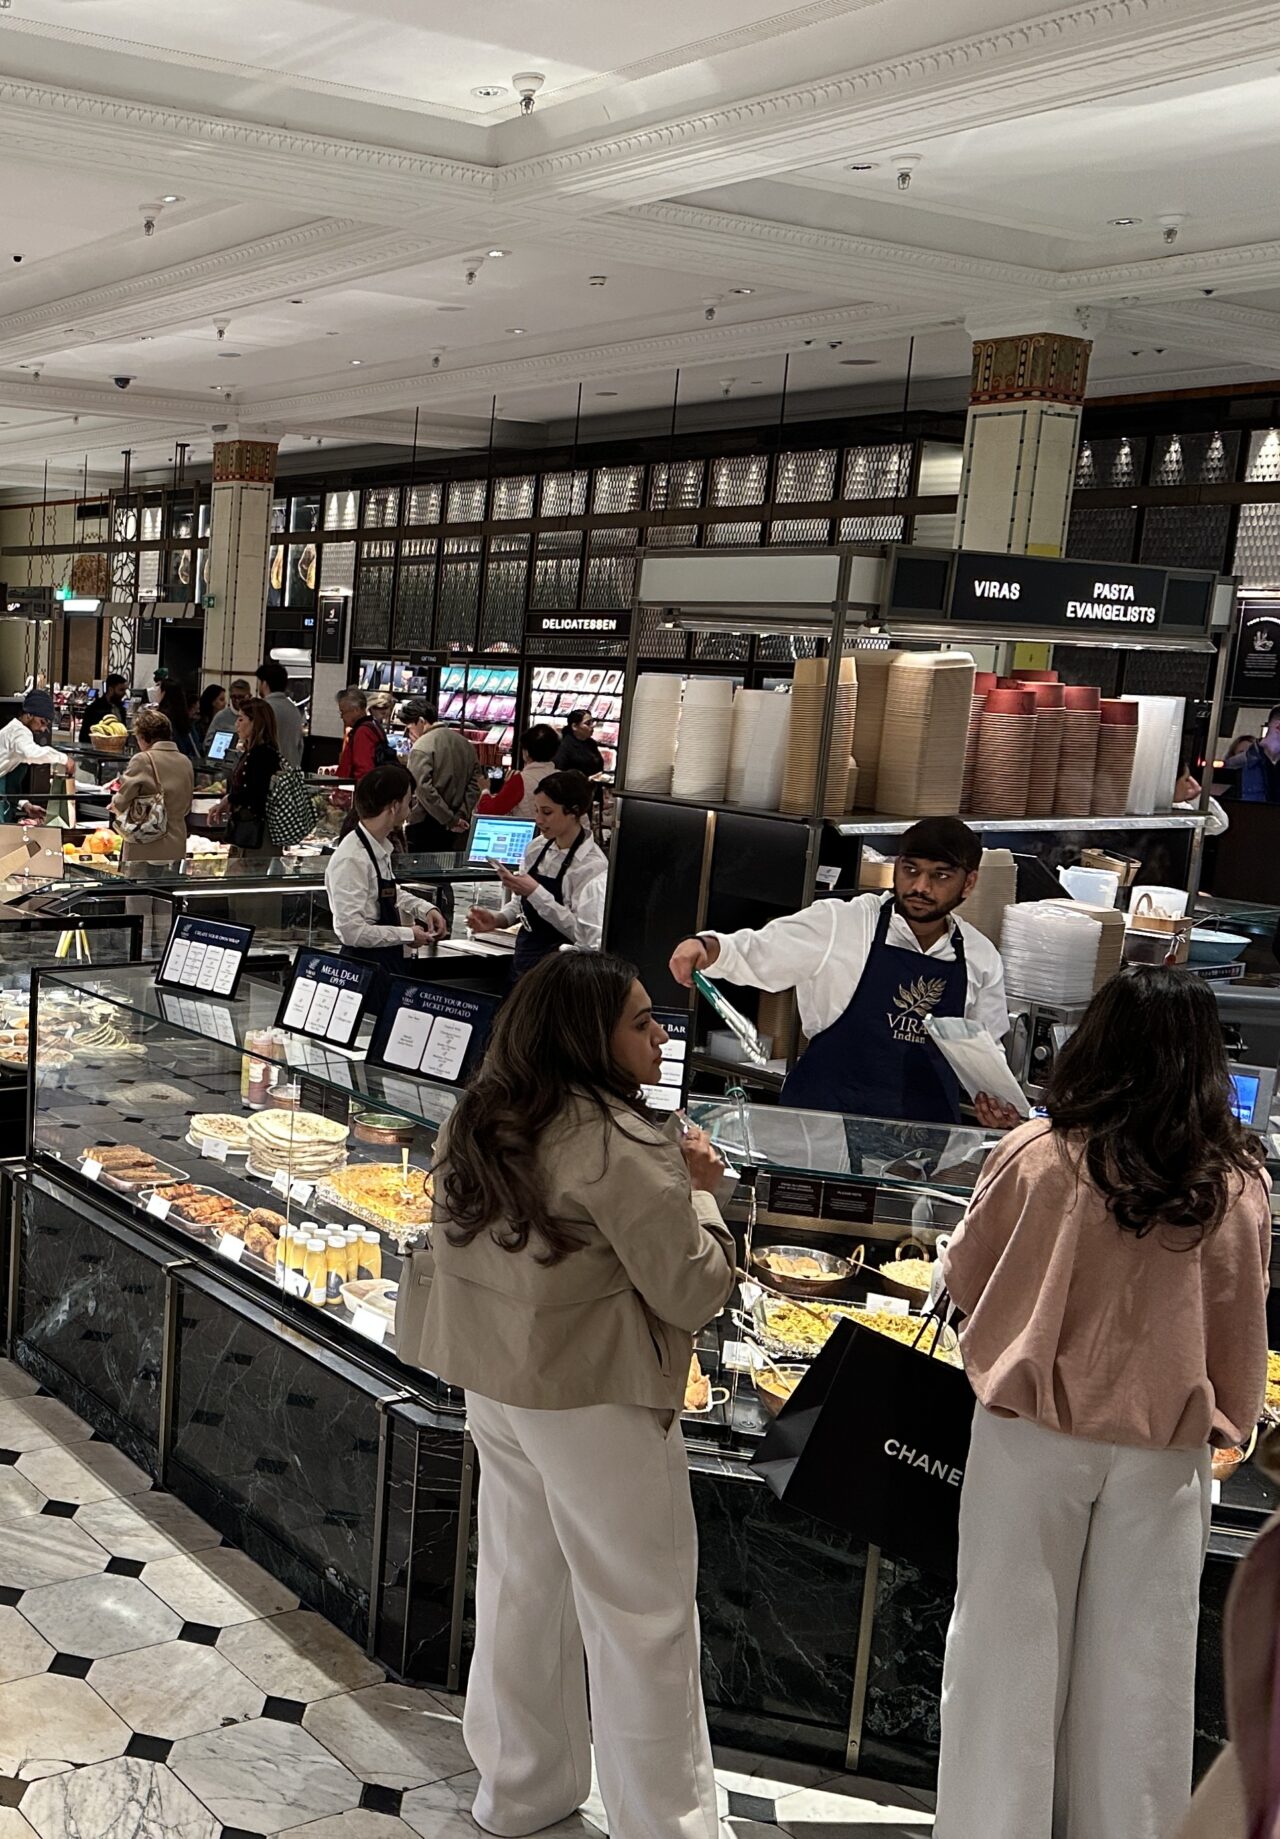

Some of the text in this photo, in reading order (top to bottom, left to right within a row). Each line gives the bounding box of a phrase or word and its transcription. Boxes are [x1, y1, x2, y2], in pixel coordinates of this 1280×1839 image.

[974, 580, 1020, 600] VIRAS
[1093, 583, 1134, 601] PASTA
[1066, 601, 1156, 623] EVANGELISTS
[541, 618, 617, 631] DELICATESSEN
[321, 965, 360, 983] MEAL DEAL
[419, 991, 479, 1011] CREATE YOUR OWN
[422, 1000, 471, 1018] JACKET POTATO
[667, 1023, 686, 1034] BAR
[886, 1012, 929, 1035] VIRA
[893, 1029, 926, 1044] Indian
[884, 1438, 963, 1487] CHANE
